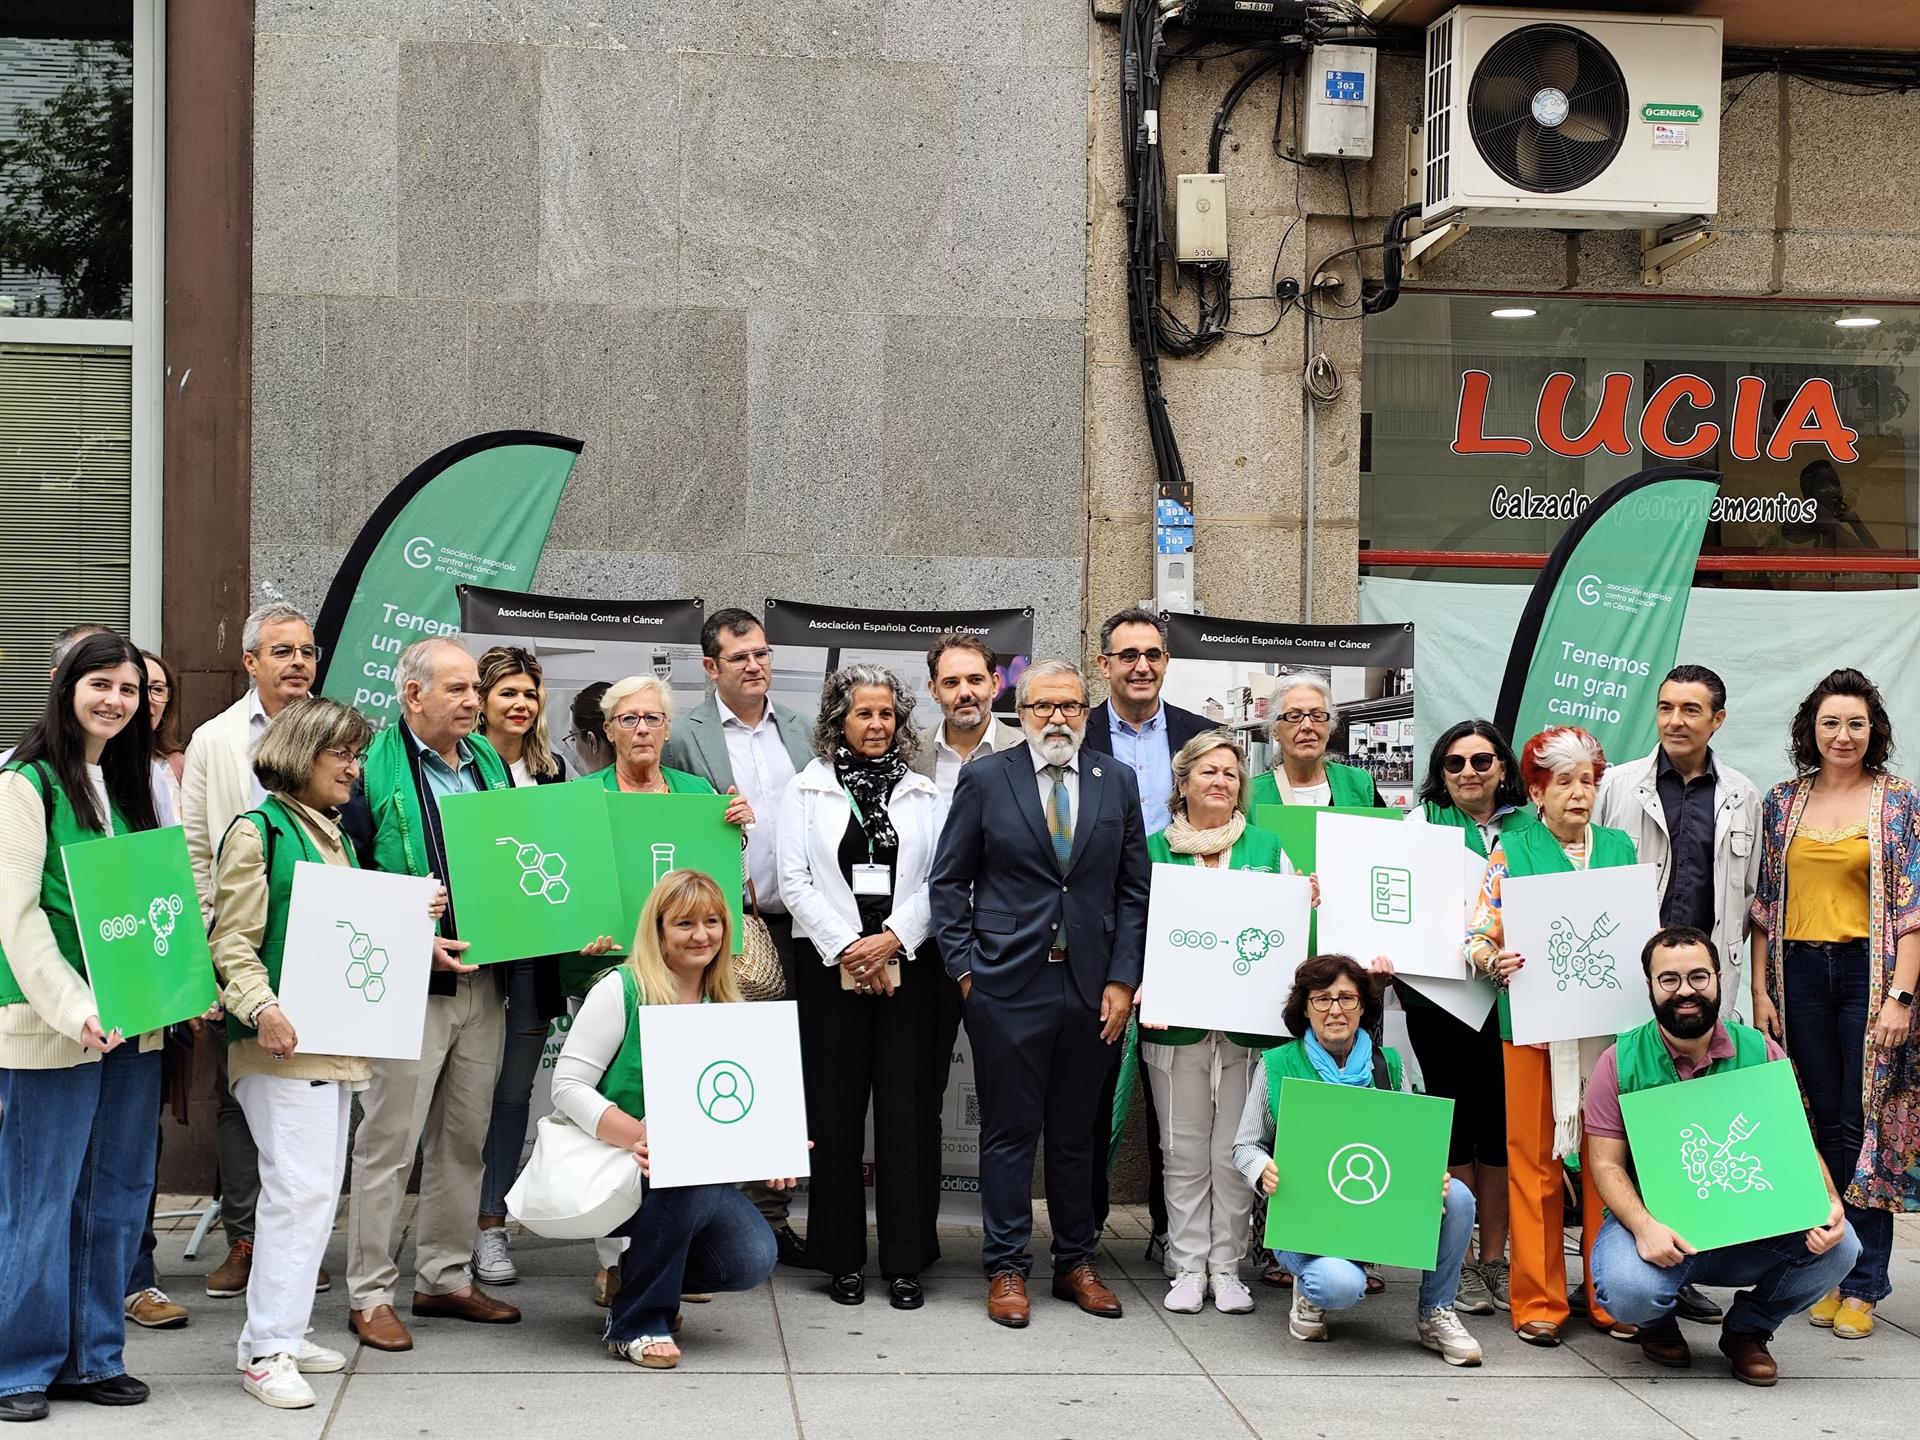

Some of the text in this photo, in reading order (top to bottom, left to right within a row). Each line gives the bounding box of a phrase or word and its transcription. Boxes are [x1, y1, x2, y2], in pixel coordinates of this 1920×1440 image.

[1337, 81, 1355, 90] 303
[1194, 249, 1213, 257] 530
[1450, 369, 1859, 464] LUCIA
[1490, 485, 1597, 520] Calzado
[1166, 508, 1185, 516] 303
[1165, 536, 1184, 545] 303
[437, 556, 464, 568] contra
[464, 562, 473, 570] el
[440, 546, 517, 572] asociación española
[434, 565, 445, 573] en
[1607, 583, 1643, 596] asociación
[1602, 600, 1613, 608] en
[1604, 592, 1627, 602] contra
[1627, 596, 1636, 604] el
[383, 602, 461, 638] Tenem
[498, 607, 664, 625] Asociación Española Contra el Cáncer
[808, 619, 990, 635] Asociación Española Contra el Cáncer
[371, 633, 402, 655] un
[1200, 633, 1371, 650] Asociación Española Contra el Cáncer
[1561, 640, 1651, 677] Tenemos
[1554, 671, 1628, 699] un gran
[352, 687, 397, 709] por
[1548, 697, 1621, 724] camino
[543, 1043, 564, 1055] AN
[957, 1144, 978, 1153] 100
[941, 1176, 979, 1192] ódico
